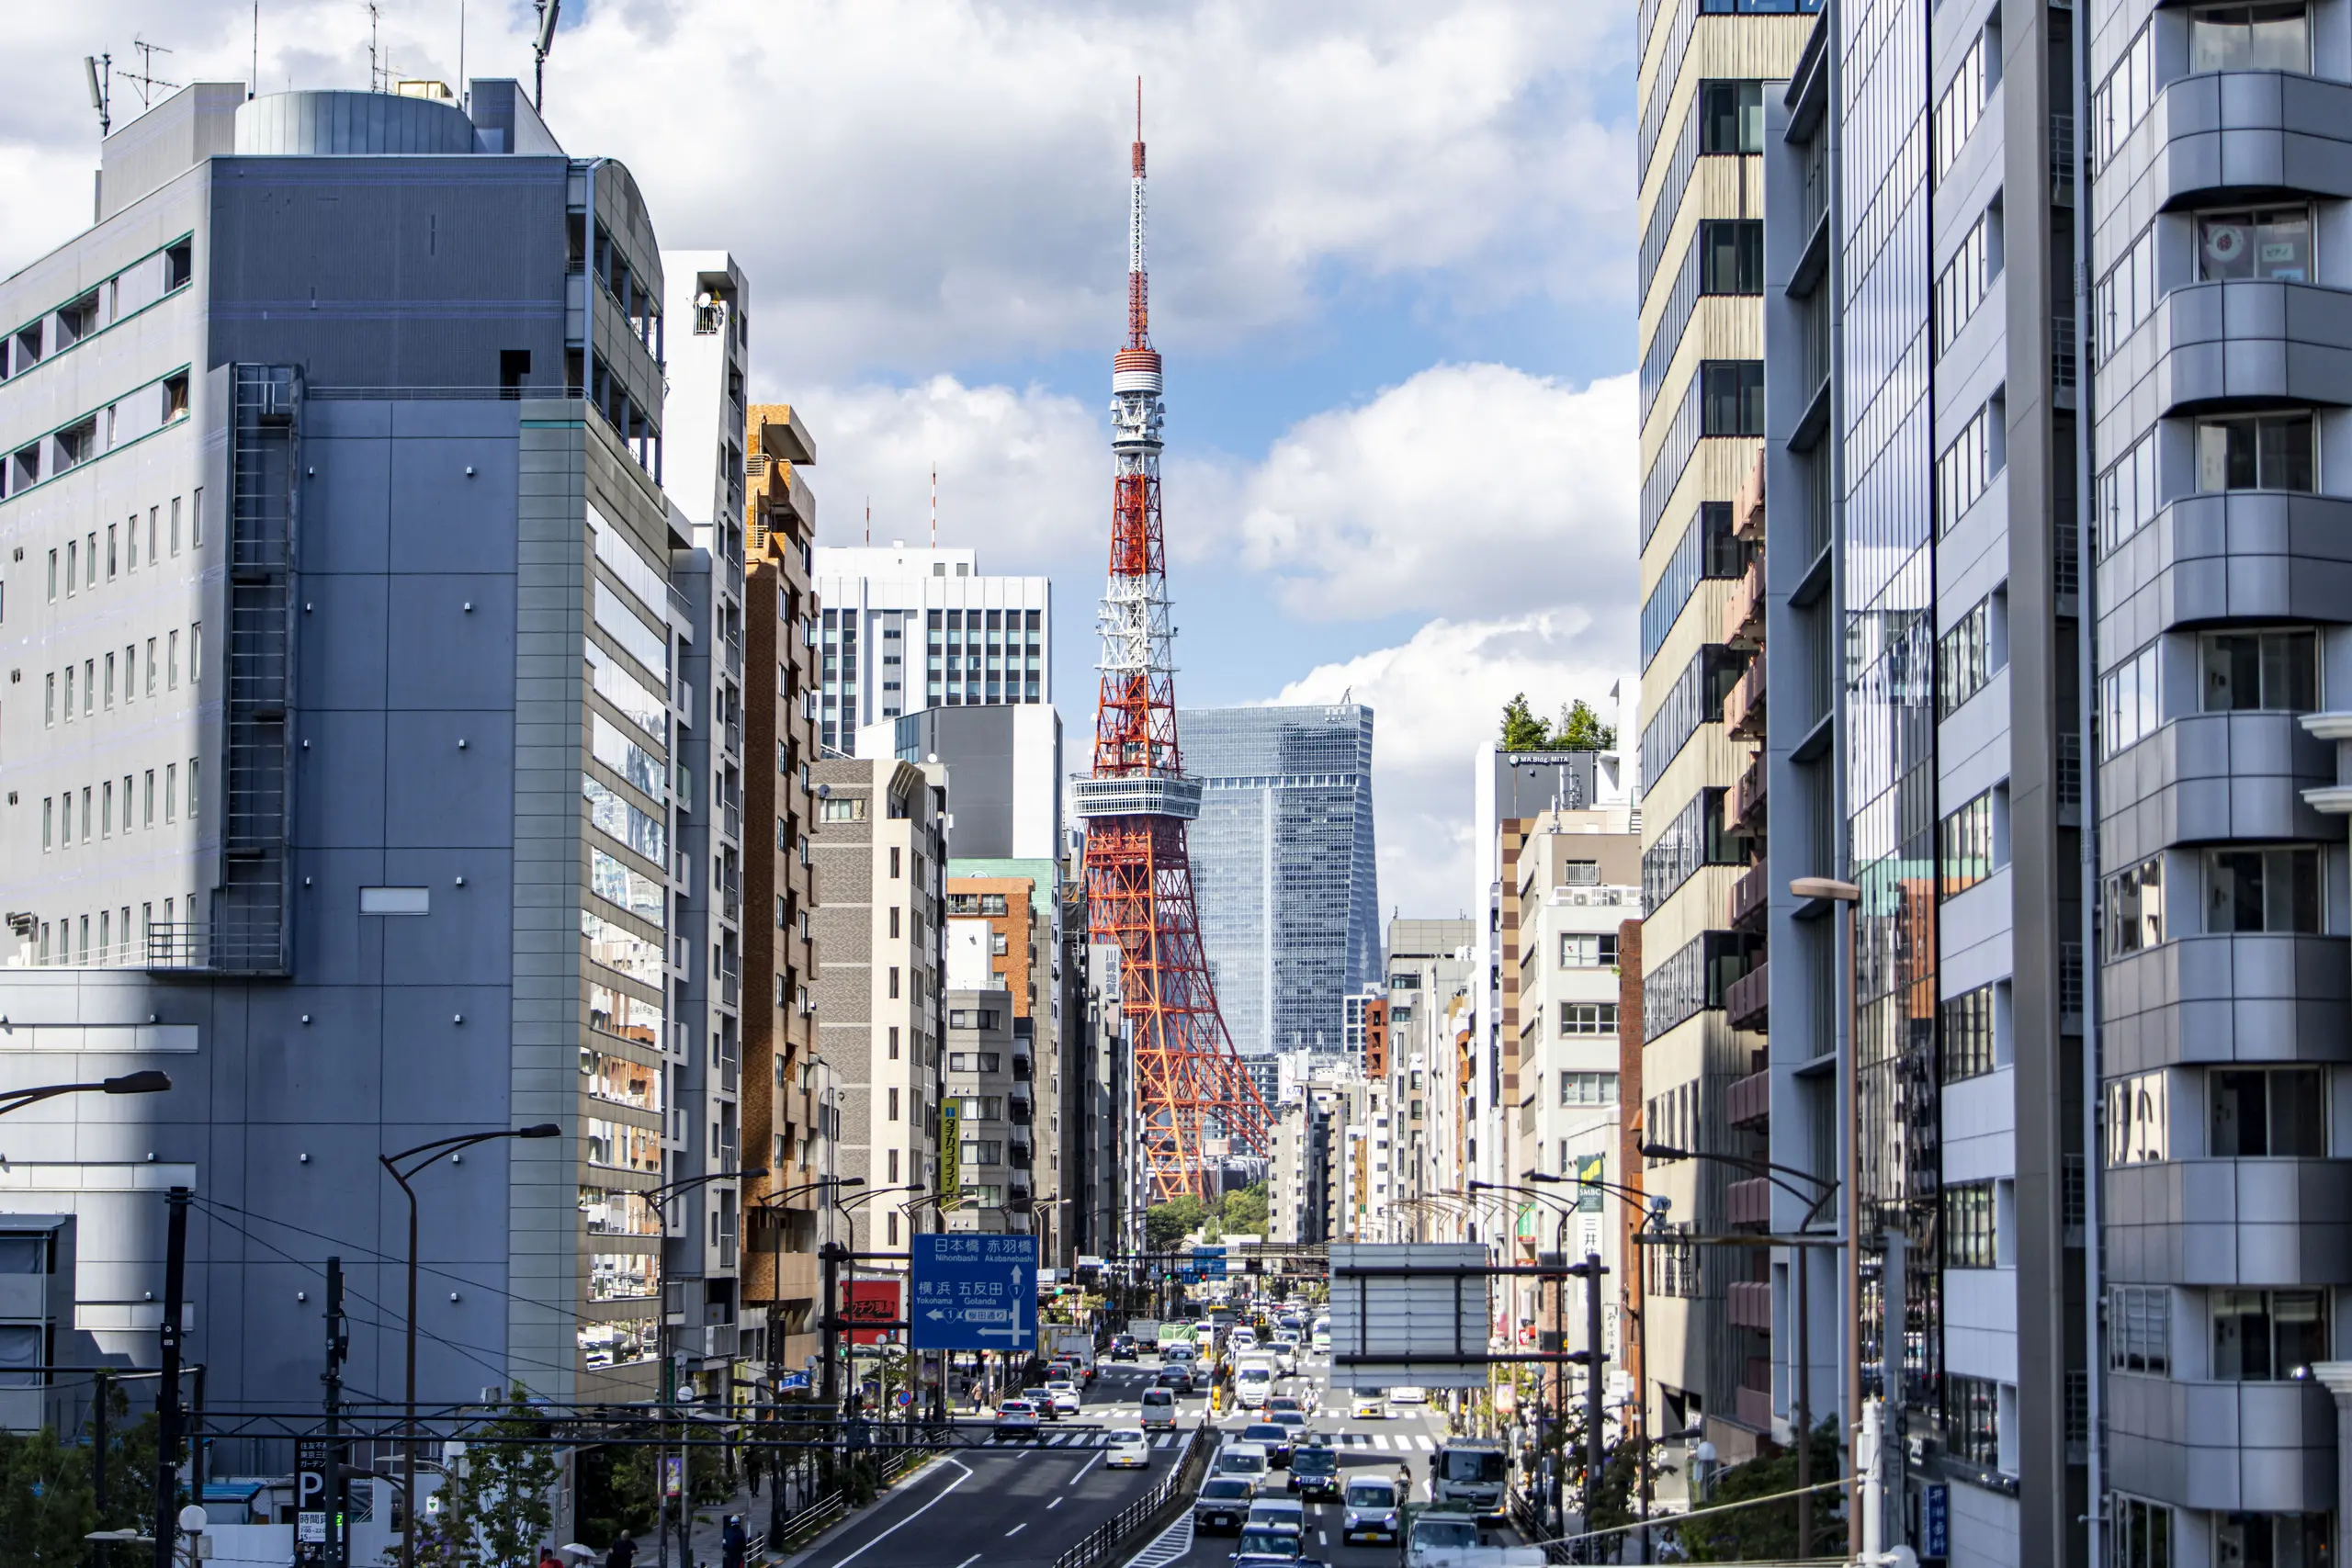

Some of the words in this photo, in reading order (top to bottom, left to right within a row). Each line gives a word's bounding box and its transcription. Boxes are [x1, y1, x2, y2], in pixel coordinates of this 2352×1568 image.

[1579, 1188, 1601, 1196] SMBC
[935, 1238, 979, 1253] 日本橋
[987, 1239, 1033, 1253] 赤羽橋
[935, 1254, 978, 1262] Nihonbashi
[919, 1281, 951, 1295] 横浜
[958, 1281, 1002, 1296] 五反田
[1013, 1286, 1019, 1295] 1
[964, 1297, 997, 1305] Gotanda
[947, 1310, 953, 1319] 1
[968, 1311, 1003, 1320] 桜田通り
[300, 1472, 322, 1507] P
